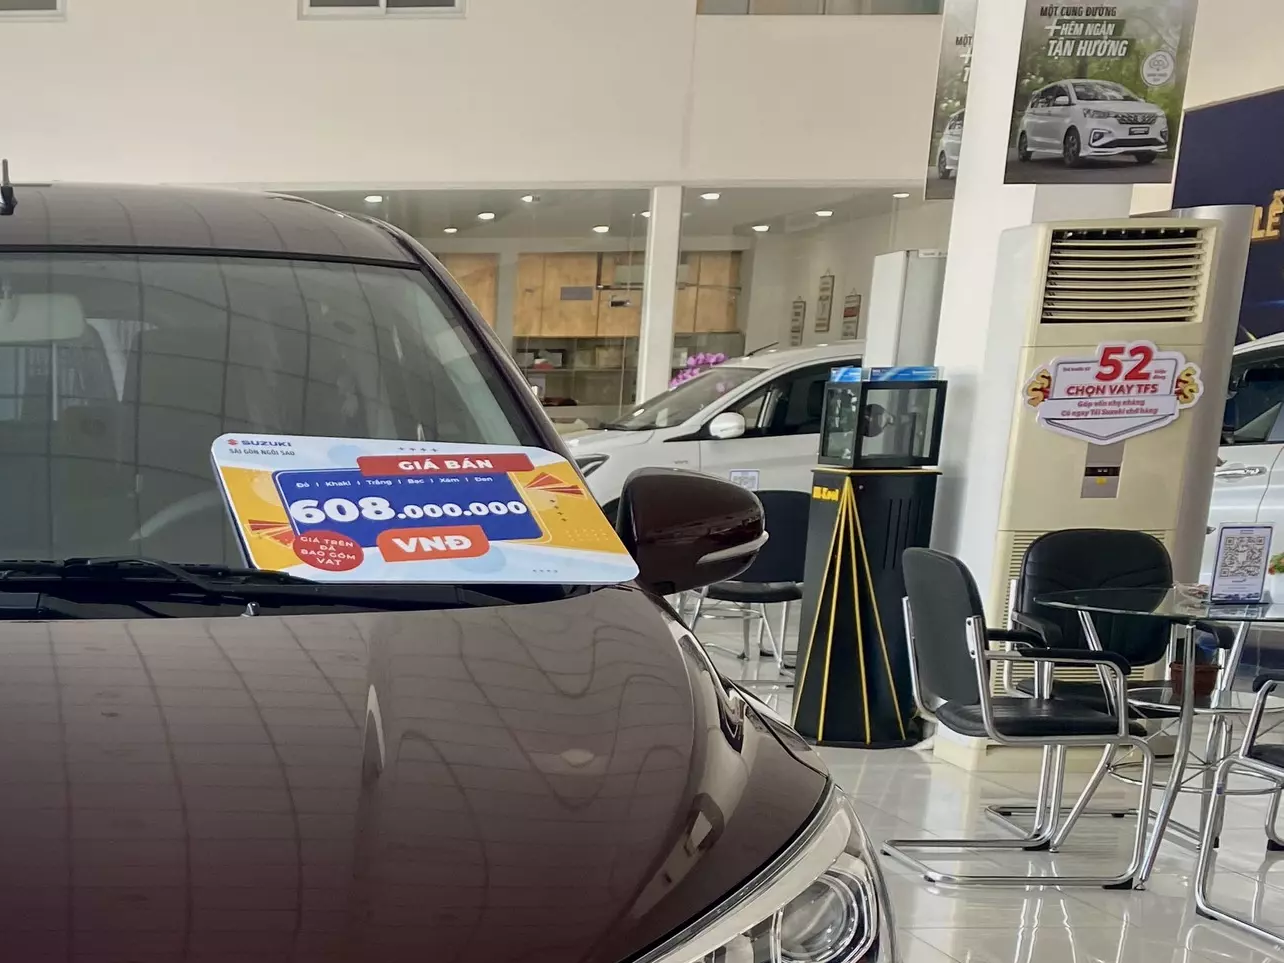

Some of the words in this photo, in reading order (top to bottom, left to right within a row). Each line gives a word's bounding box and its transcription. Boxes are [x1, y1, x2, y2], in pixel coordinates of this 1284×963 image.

[1095, 345, 1154, 381] 52
[1066, 385, 1106, 398] CHỌN
[1109, 384, 1134, 394] VAY
[1136, 384, 1159, 393] TFS
[398, 458, 440, 470] GIÁ
[444, 457, 494, 469] BÁN
[289, 496, 527, 524] 608.000.000
[392, 535, 472, 553] VNĐ
[316, 558, 342, 566] VAT
